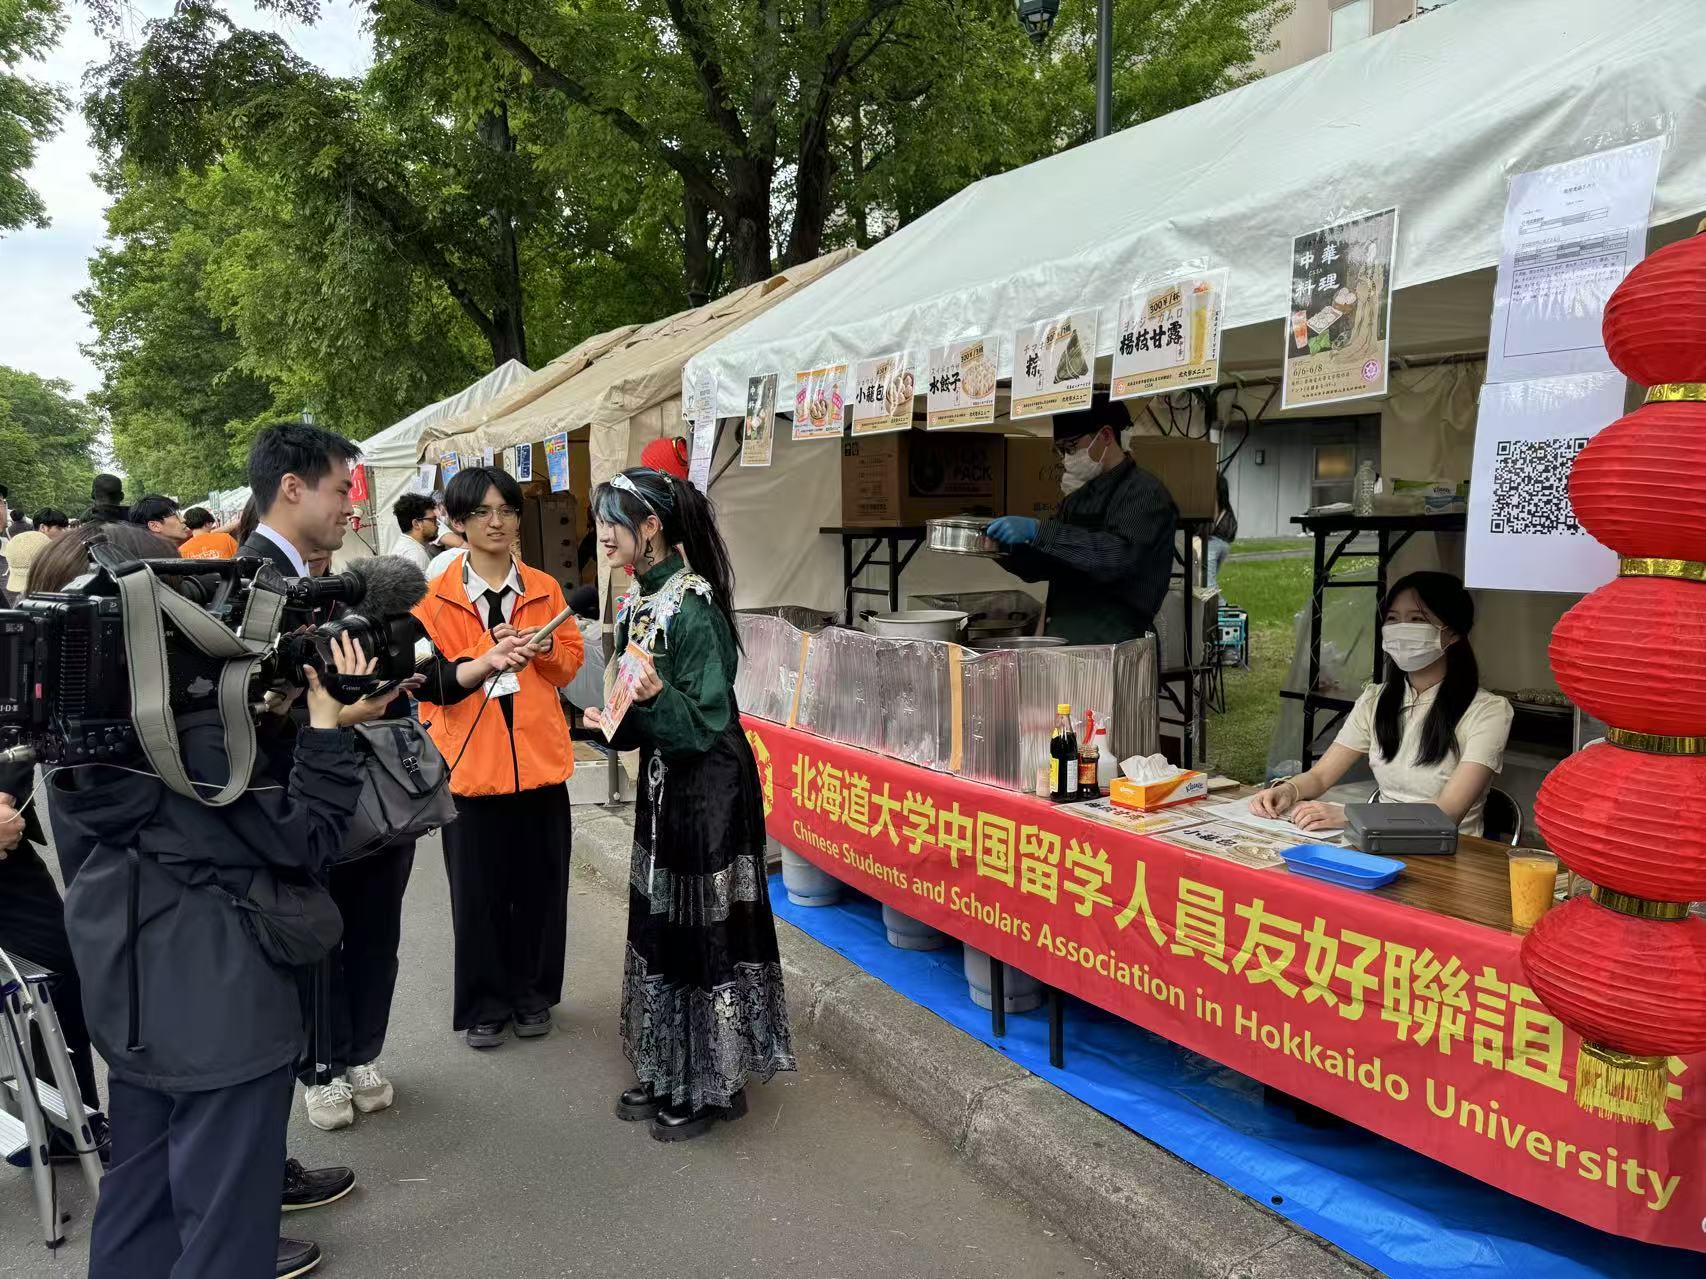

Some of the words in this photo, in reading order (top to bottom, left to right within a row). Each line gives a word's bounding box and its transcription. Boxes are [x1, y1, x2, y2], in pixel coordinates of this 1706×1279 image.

[1119, 320, 1183, 357] 楊枝甘露
[929, 371, 961, 395] 水餃子
[793, 820, 839, 859] Chinese
[842, 844, 908, 889] Students
[913, 877, 944, 905] and
[950, 886, 1031, 942] Scholars
[1038, 924, 1186, 1010] Association
[1196, 987, 1223, 1026] in
[1235, 1004, 1410, 1101] Hokkaido
[1426, 1078, 1682, 1211] University
